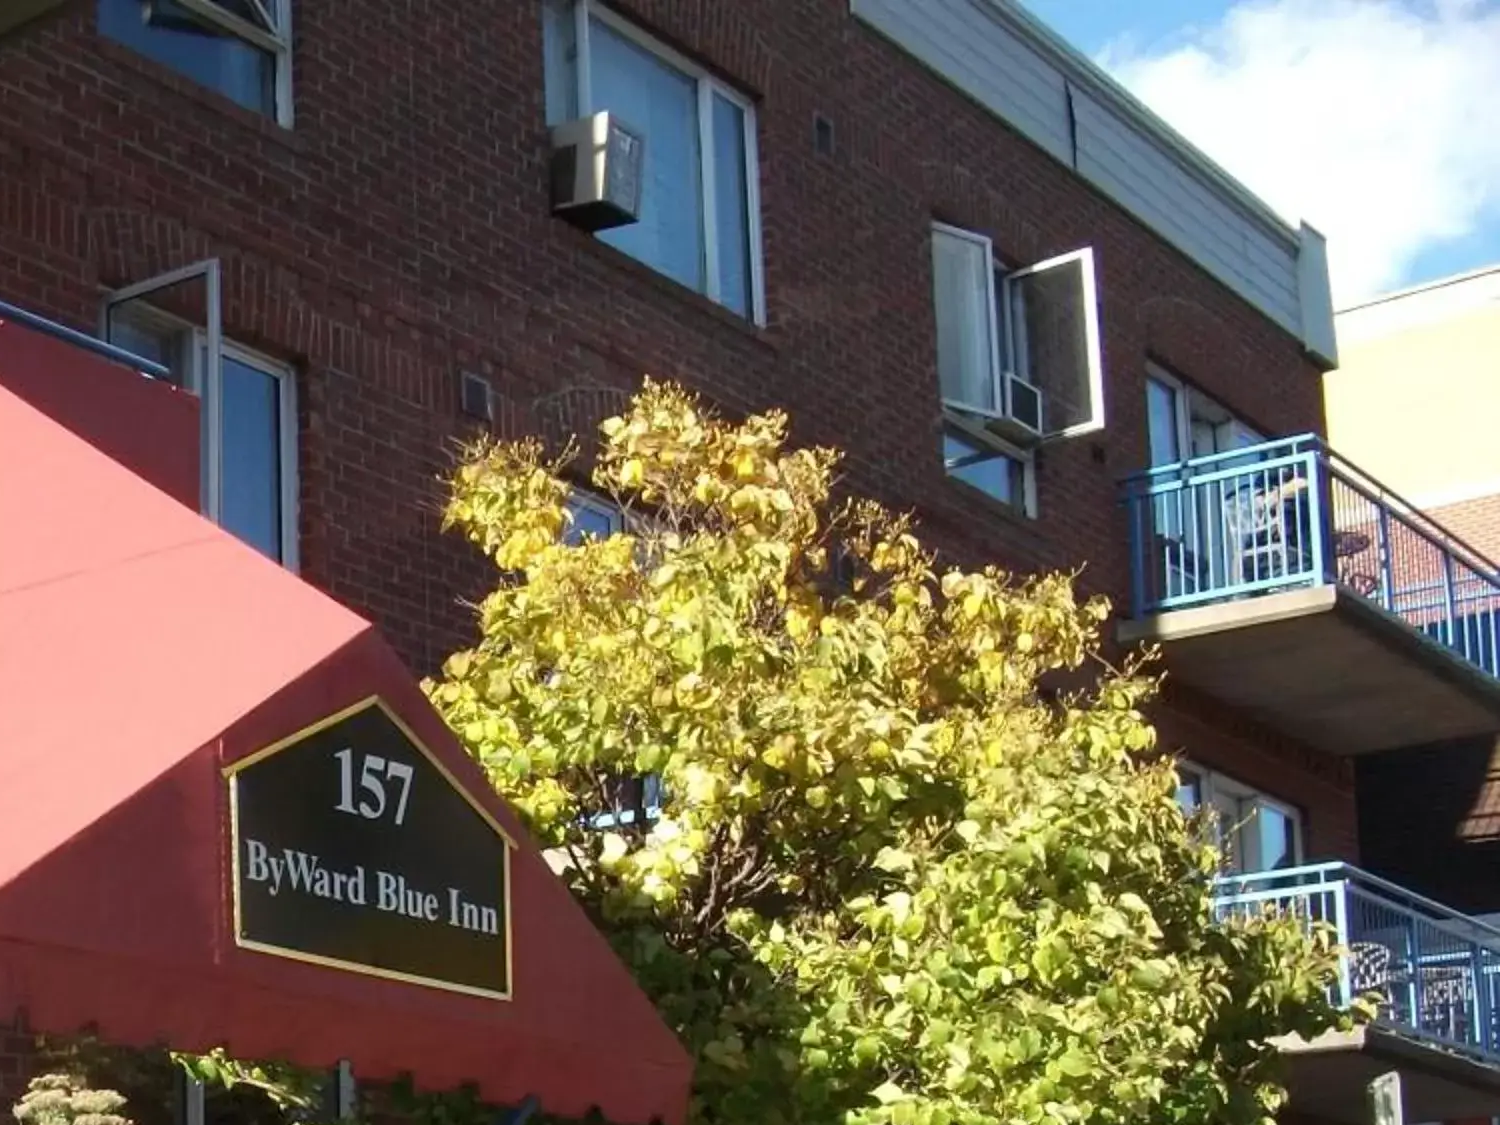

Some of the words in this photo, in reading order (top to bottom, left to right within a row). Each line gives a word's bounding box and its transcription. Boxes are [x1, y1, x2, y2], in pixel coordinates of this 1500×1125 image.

[334, 747, 414, 825] 157
[246, 838, 366, 905] ByWard
[376, 871, 439, 921] Blue
[448, 887, 499, 935] Inn
